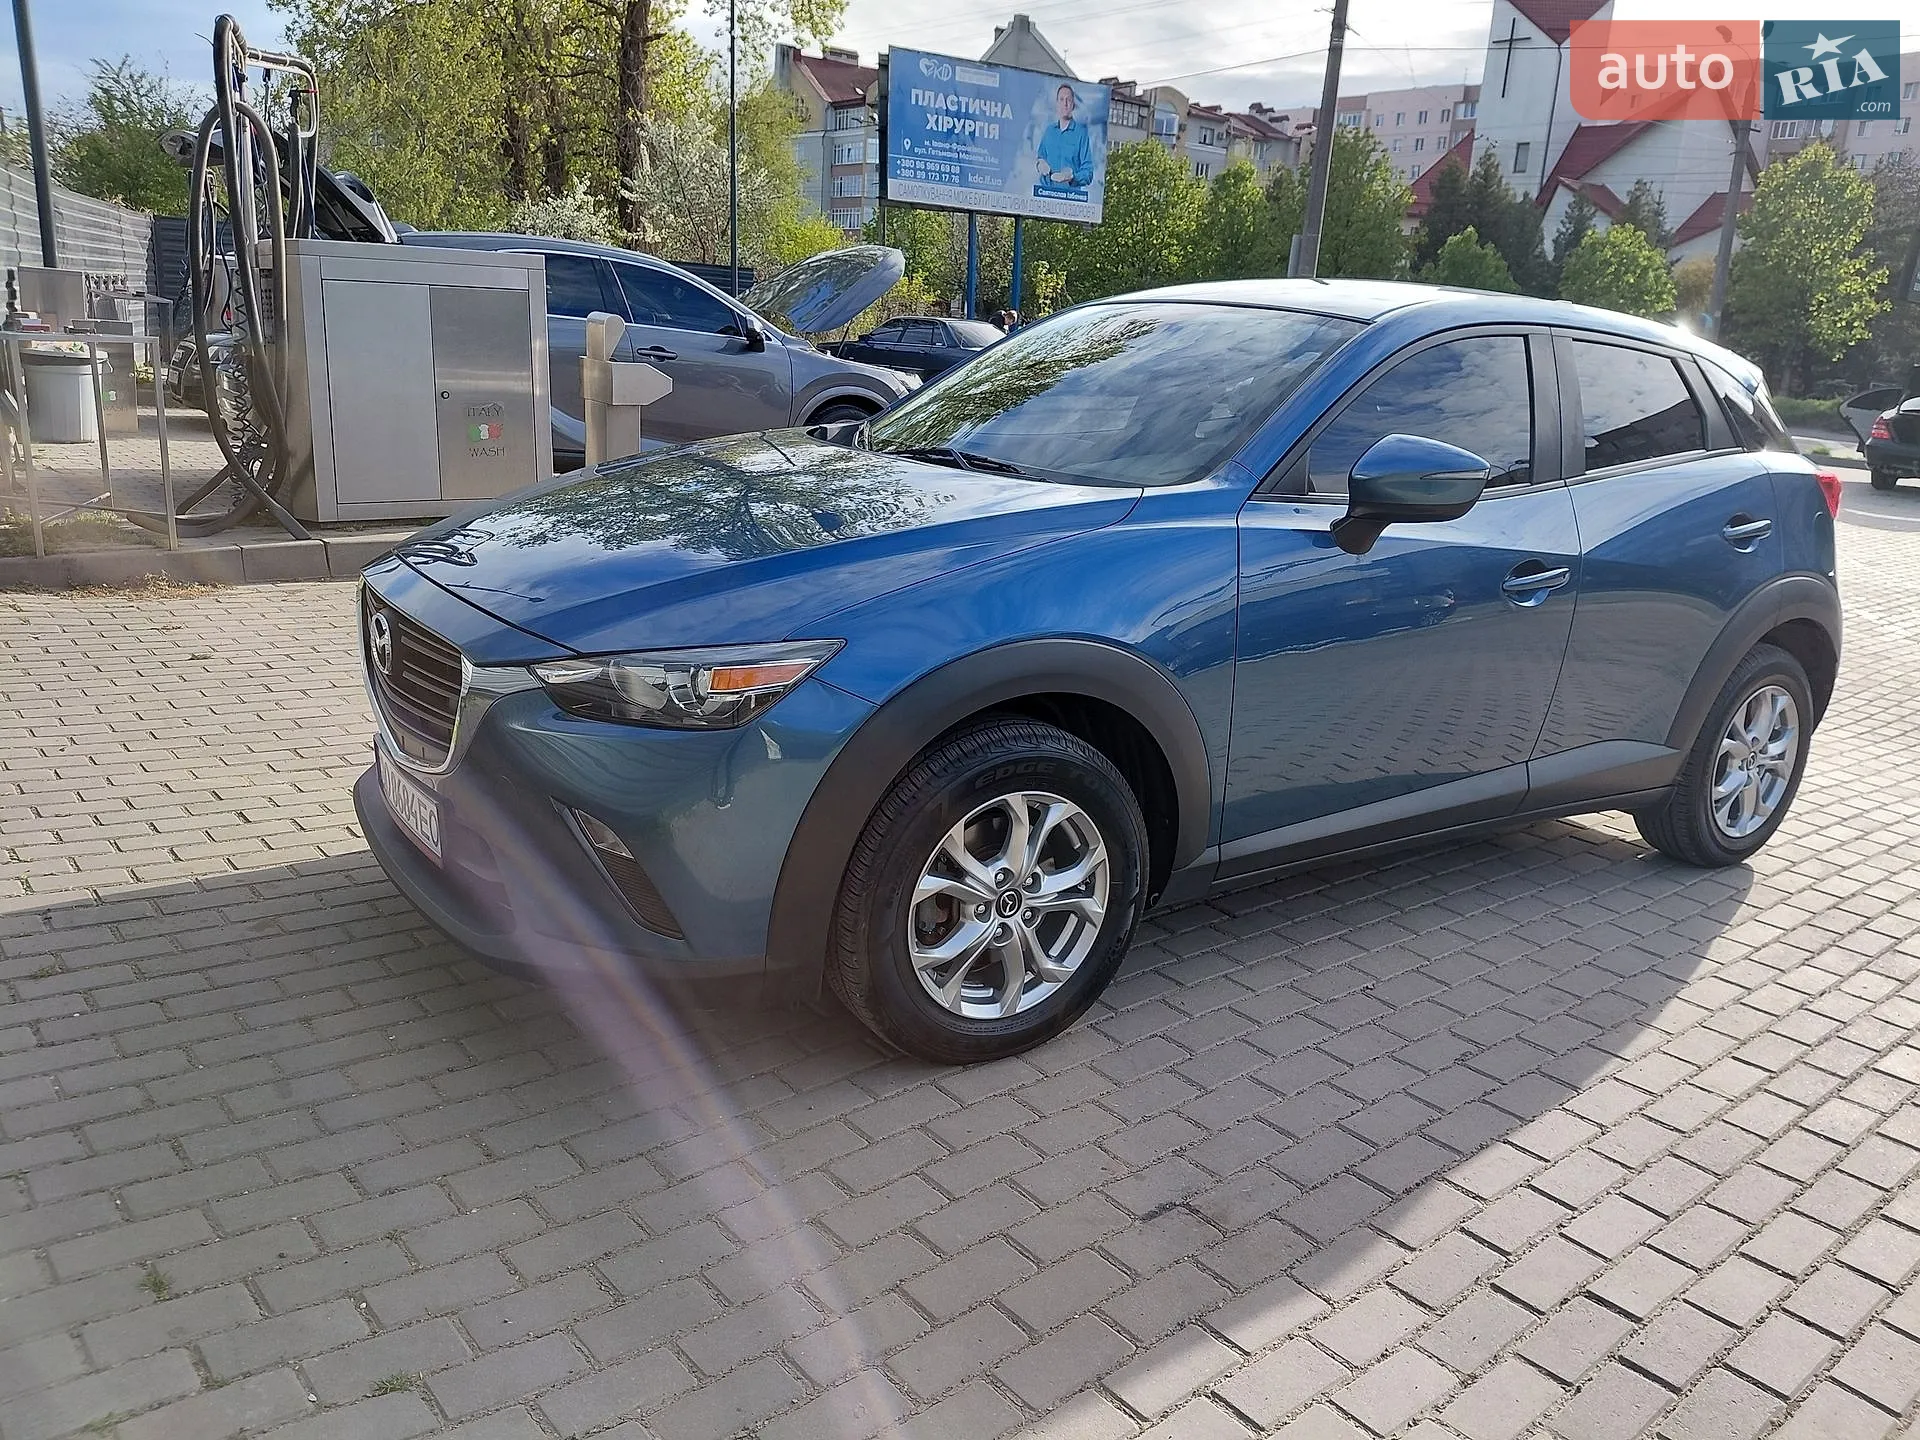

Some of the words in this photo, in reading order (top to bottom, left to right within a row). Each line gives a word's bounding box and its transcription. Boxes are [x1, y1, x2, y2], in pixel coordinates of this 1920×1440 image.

[911, 88, 1013, 120] ПЛАСТИЧНА
[926, 113, 1000, 140] ХІРУРГІЯ
[897, 158, 915, 168] +380
[896, 168, 915, 178] +380
[928, 172, 940, 181] 173
[942, 173, 949, 182] 17
[467, 407, 502, 417] ITALY
[468, 447, 505, 457] WASH
